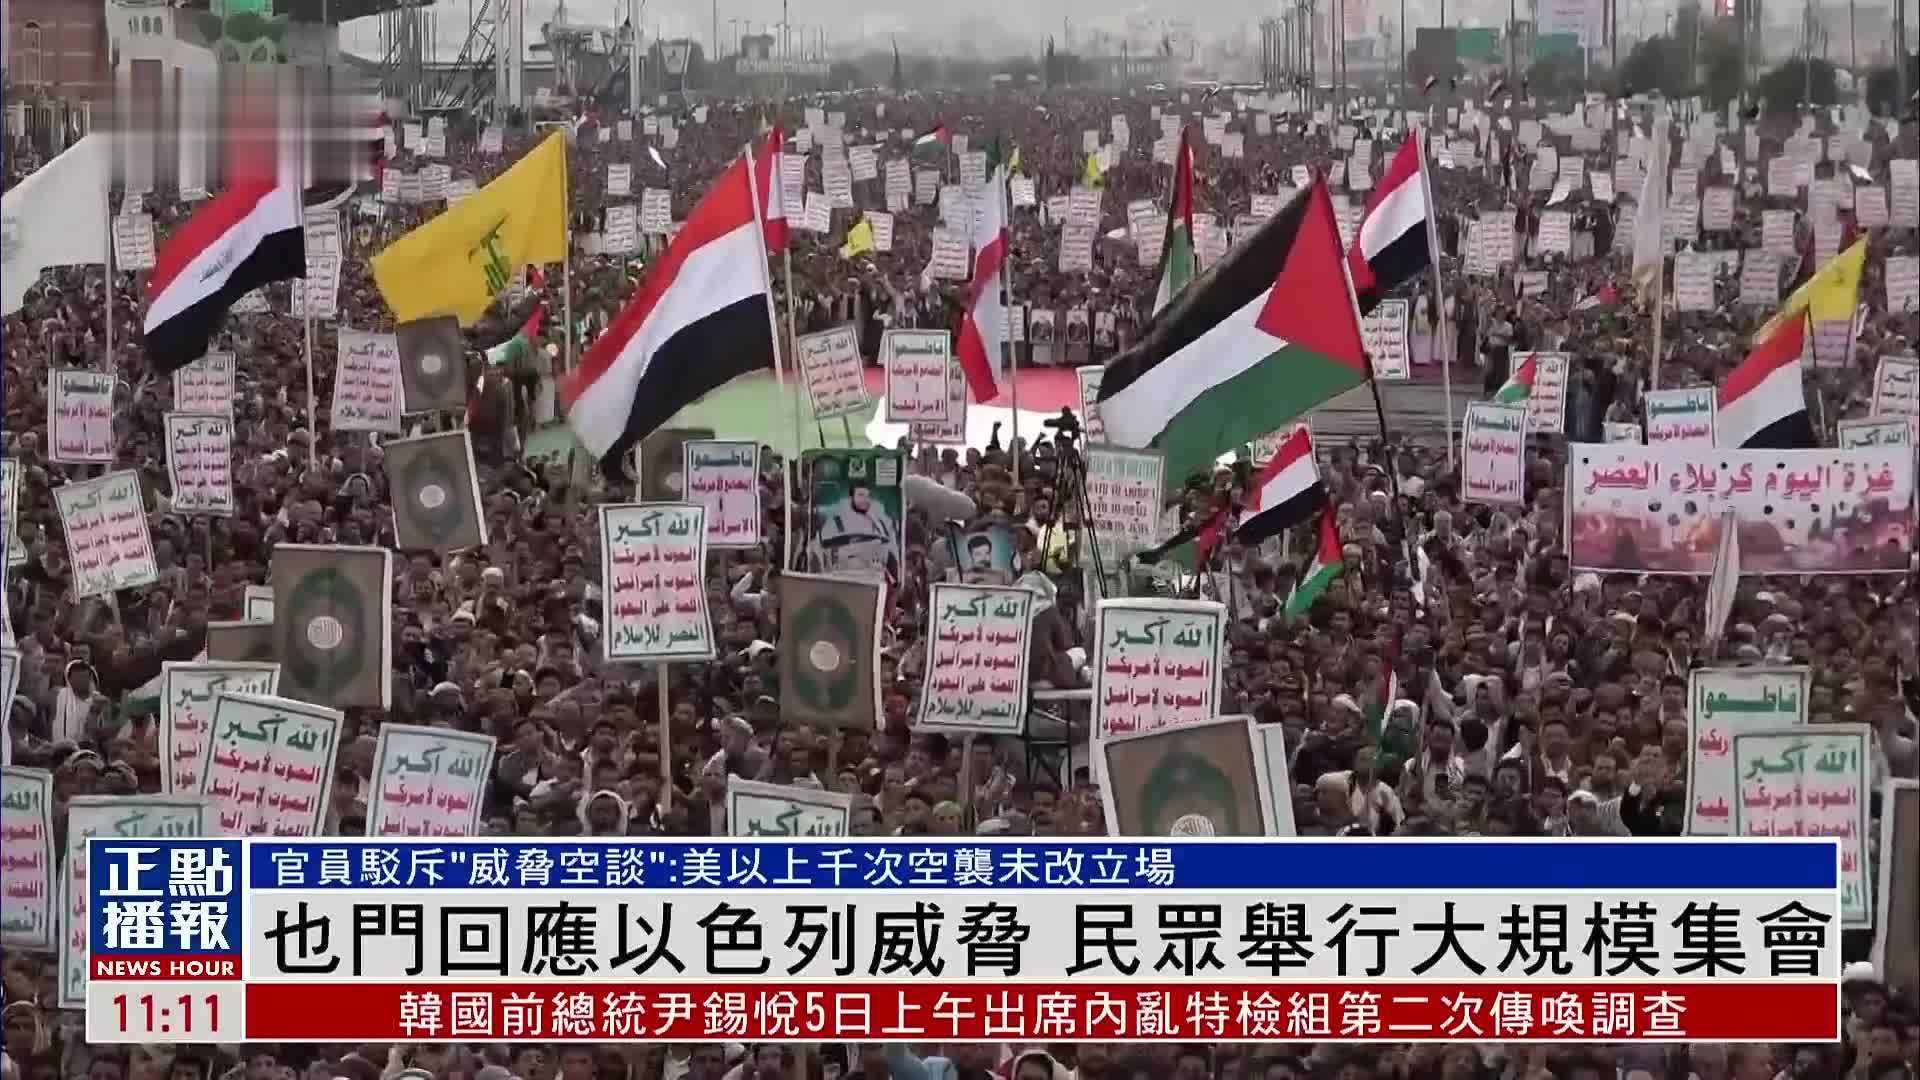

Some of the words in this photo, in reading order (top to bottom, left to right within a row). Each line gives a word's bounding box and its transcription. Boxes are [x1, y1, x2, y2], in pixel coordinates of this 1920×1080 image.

[1765, 461, 1832, 499] اليوم
[1843, 462, 1895, 498] غزة
[668, 513, 699, 536] الله
[993, 595, 1026, 618] الله
[1109, 616, 1171, 652] أكبر
[1173, 622, 1212, 648] الله
[1699, 683, 1797, 719] قاطعوا
[221, 713, 288, 747] أكبر
[287, 723, 328, 751] الله
[448, 751, 482, 780] الله
[1743, 741, 1812, 782] أكبر
[1816, 745, 1857, 773] الله
